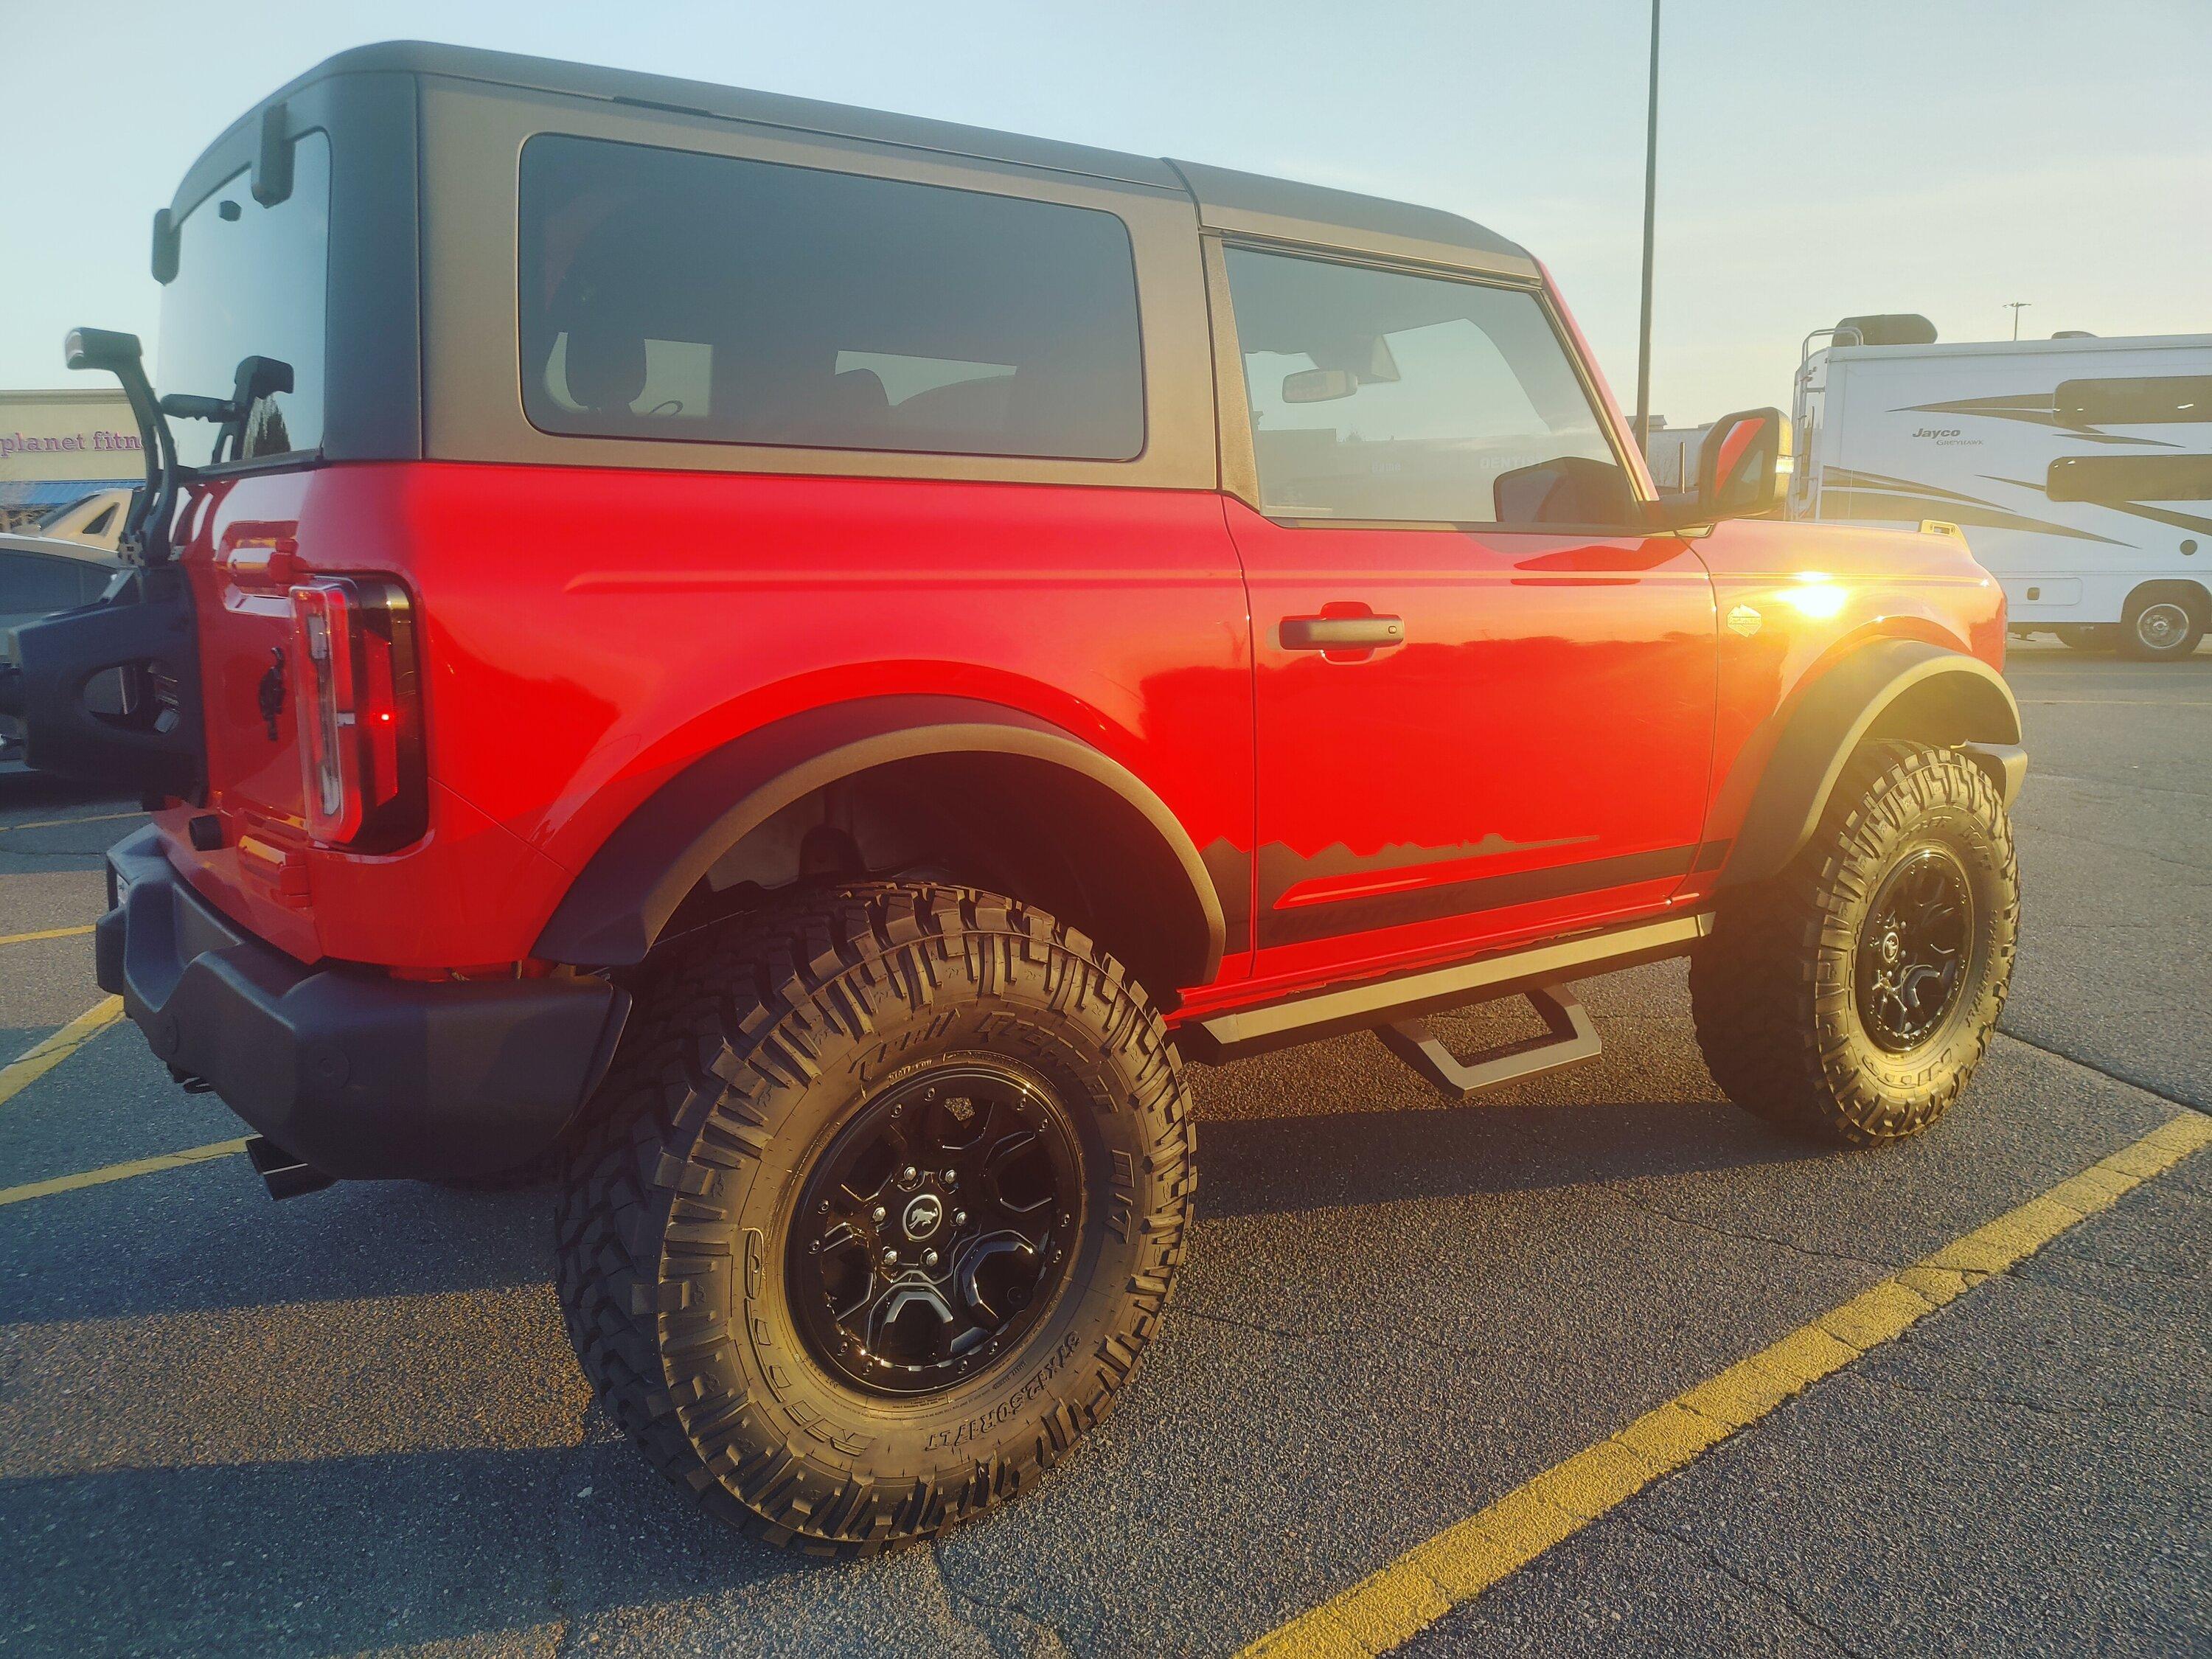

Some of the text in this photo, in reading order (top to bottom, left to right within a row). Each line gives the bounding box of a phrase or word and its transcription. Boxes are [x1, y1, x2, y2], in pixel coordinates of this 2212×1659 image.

[1912, 428, 1961, 439] Jayco
[0, 431, 142, 458] planet fitn
